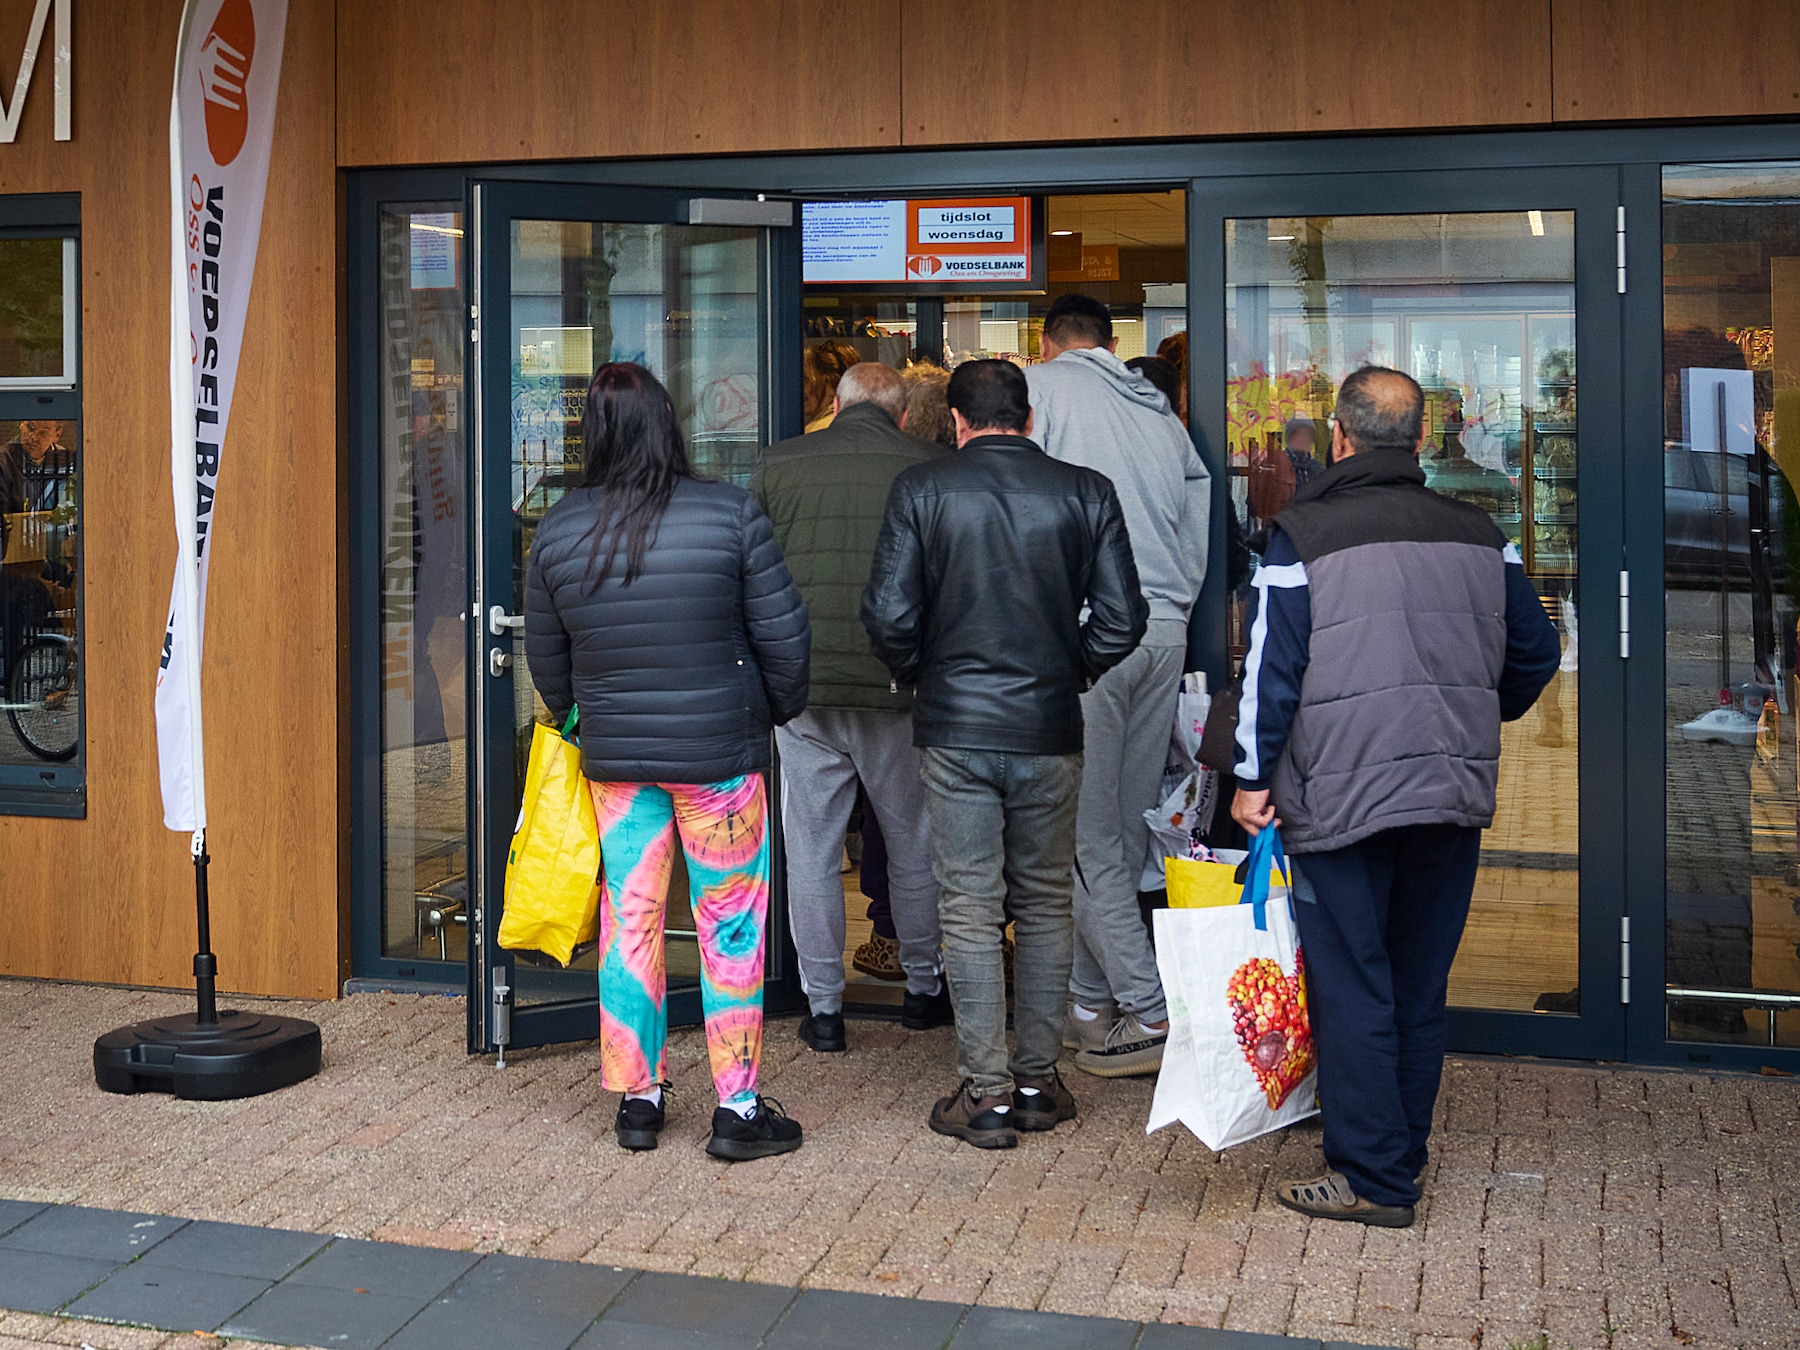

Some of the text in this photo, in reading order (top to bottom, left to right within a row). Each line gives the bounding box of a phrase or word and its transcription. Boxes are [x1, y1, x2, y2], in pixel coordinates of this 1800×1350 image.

[188, 173, 204, 253] Oss
[941, 212, 991, 223] tijdslot
[928, 230, 1003, 240] woensdag
[945, 261, 1025, 270] VOEDSELBANK
